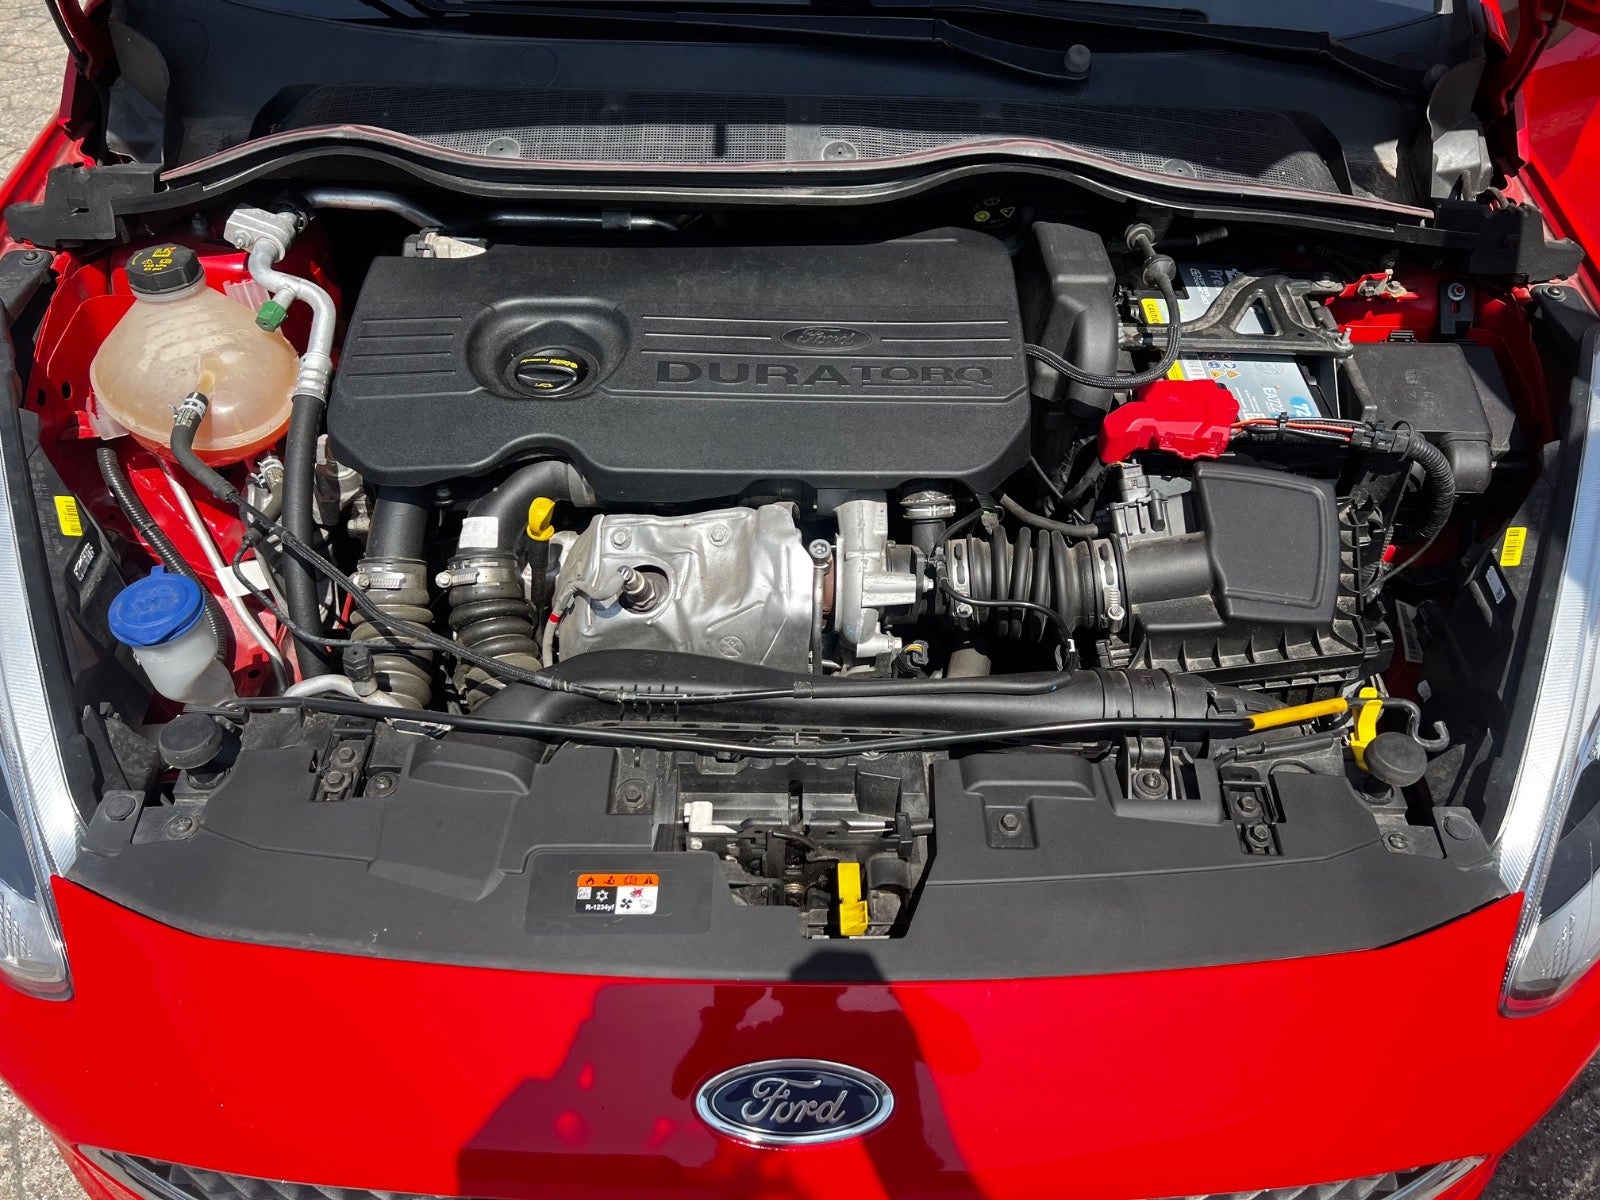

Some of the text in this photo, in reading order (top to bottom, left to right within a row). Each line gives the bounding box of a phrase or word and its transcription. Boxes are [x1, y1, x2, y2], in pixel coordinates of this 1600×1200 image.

[797, 327, 856, 345] Ford
[656, 360, 994, 388] DURATORQ
[1293, 403, 1312, 418] 72
[585, 903, 615, 912] R-1234yf
[741, 1077, 849, 1125] Ford
